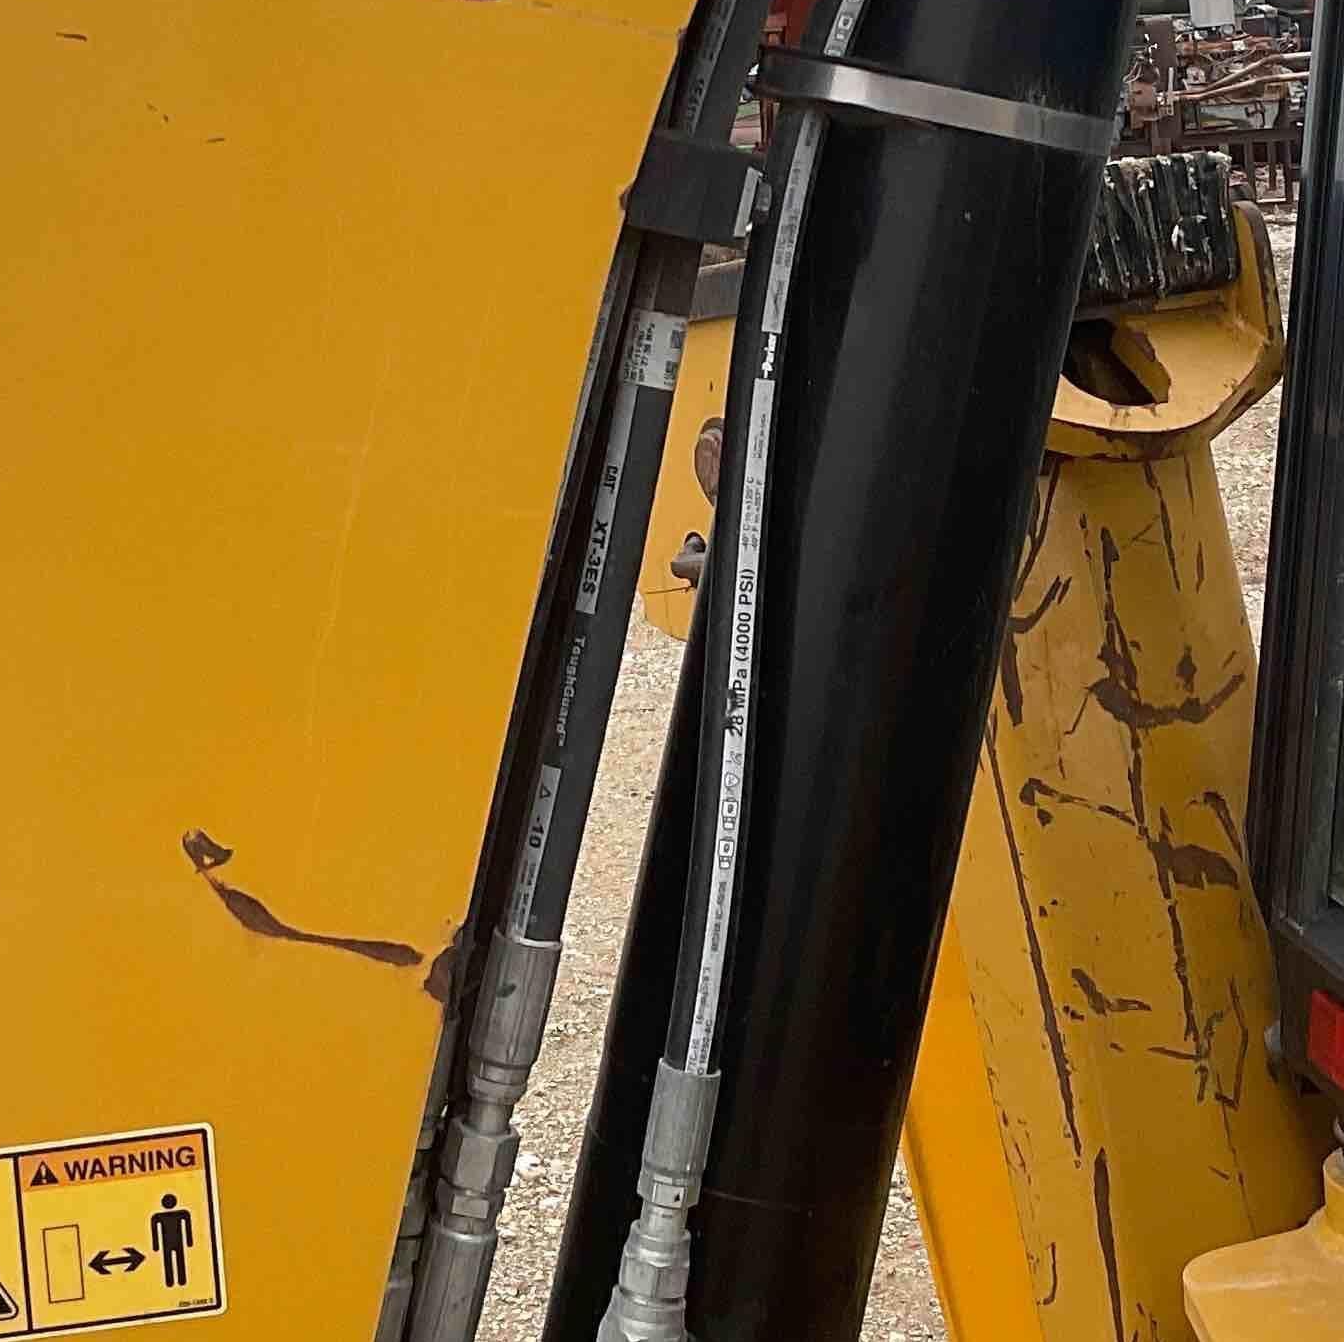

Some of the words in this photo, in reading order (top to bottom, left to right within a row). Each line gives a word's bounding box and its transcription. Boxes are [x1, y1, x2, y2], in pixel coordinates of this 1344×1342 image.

[582, 520, 608, 594] XT-3ES
[739, 569, 755, 605] PSI)
[735, 612, 751, 662] (4000
[730, 714, 744, 737] 28
[64, 1146, 196, 1181] WARNING
